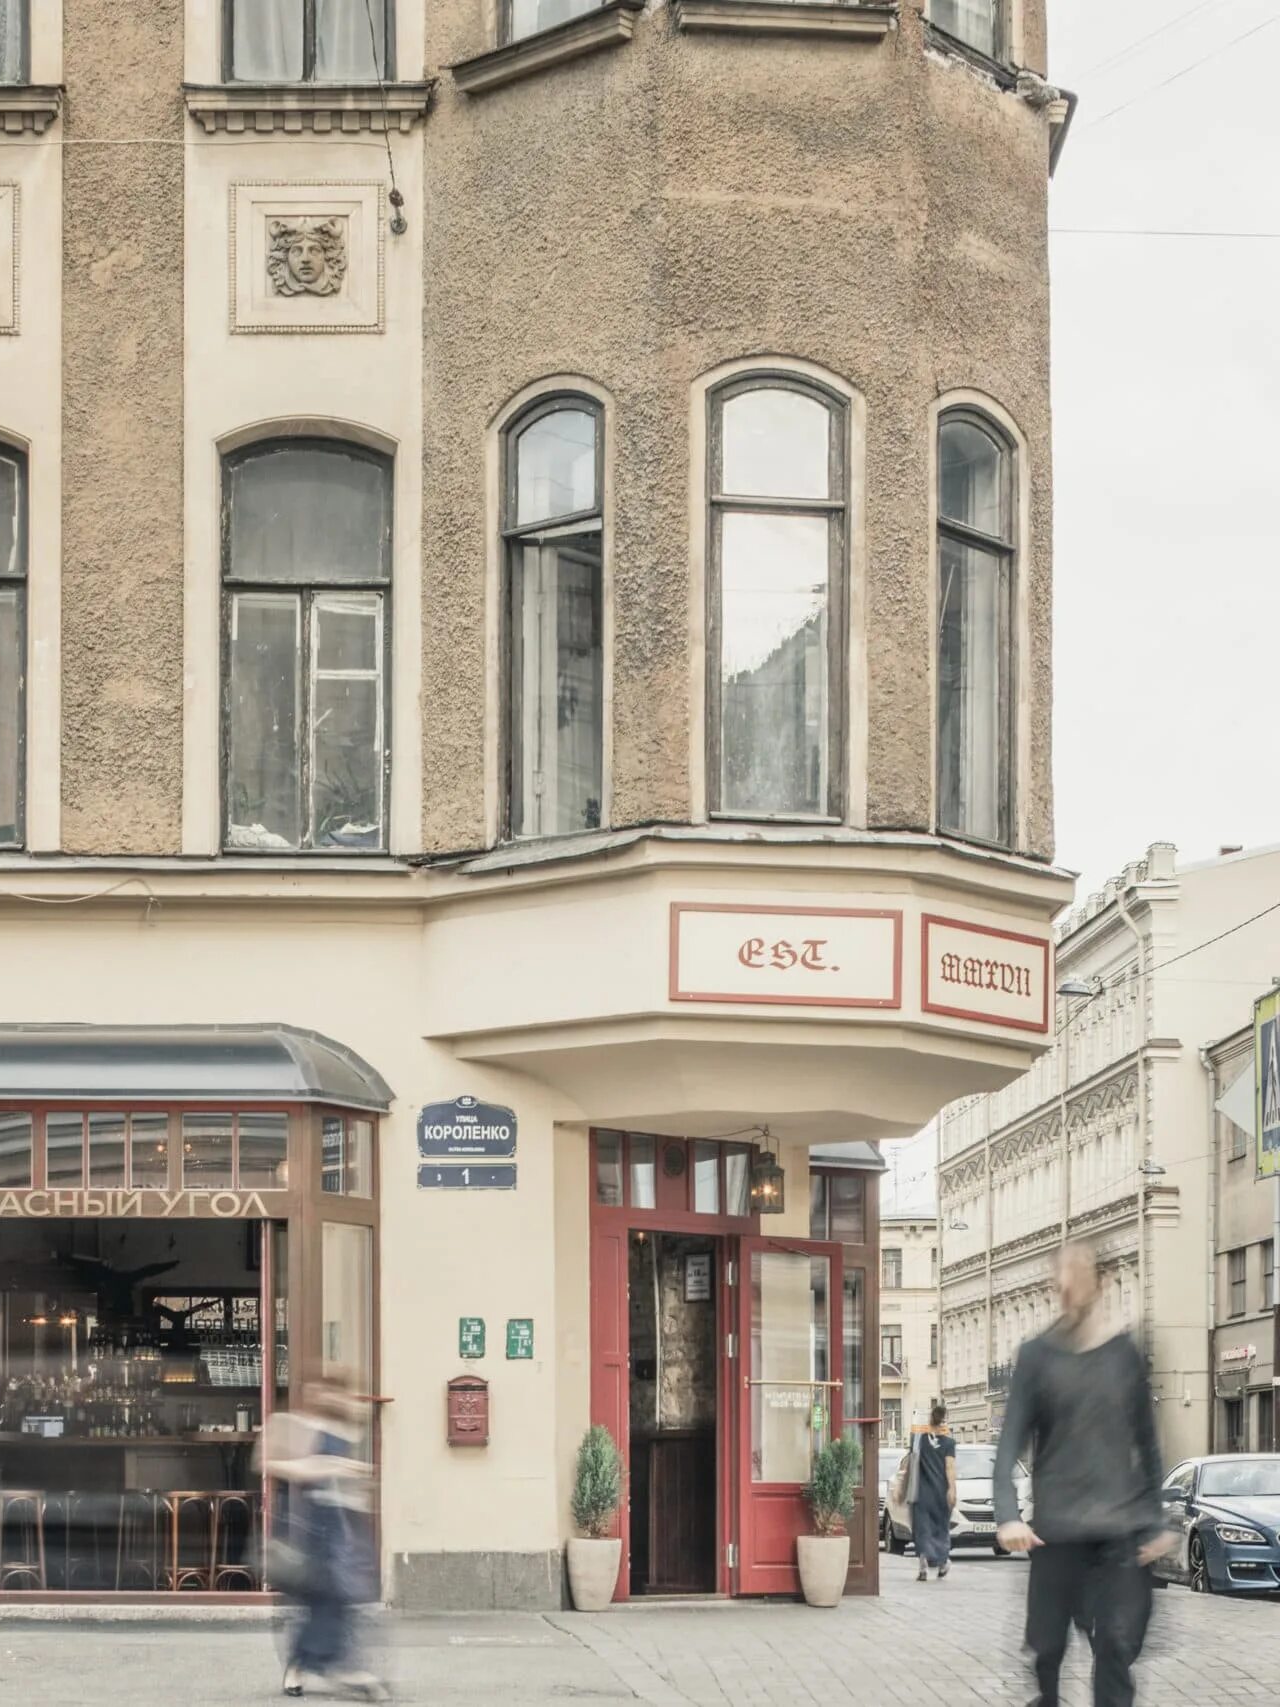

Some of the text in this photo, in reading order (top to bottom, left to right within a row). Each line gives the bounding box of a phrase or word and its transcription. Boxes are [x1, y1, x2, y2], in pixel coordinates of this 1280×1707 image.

[738, 938, 841, 972] EST.
[941, 952, 1031, 997] MMXVII
[424, 1125, 510, 1140] КОРОЛЕНКО
[462, 1168, 470, 1184] 1
[159, 1191, 269, 1217] УГОЛ
